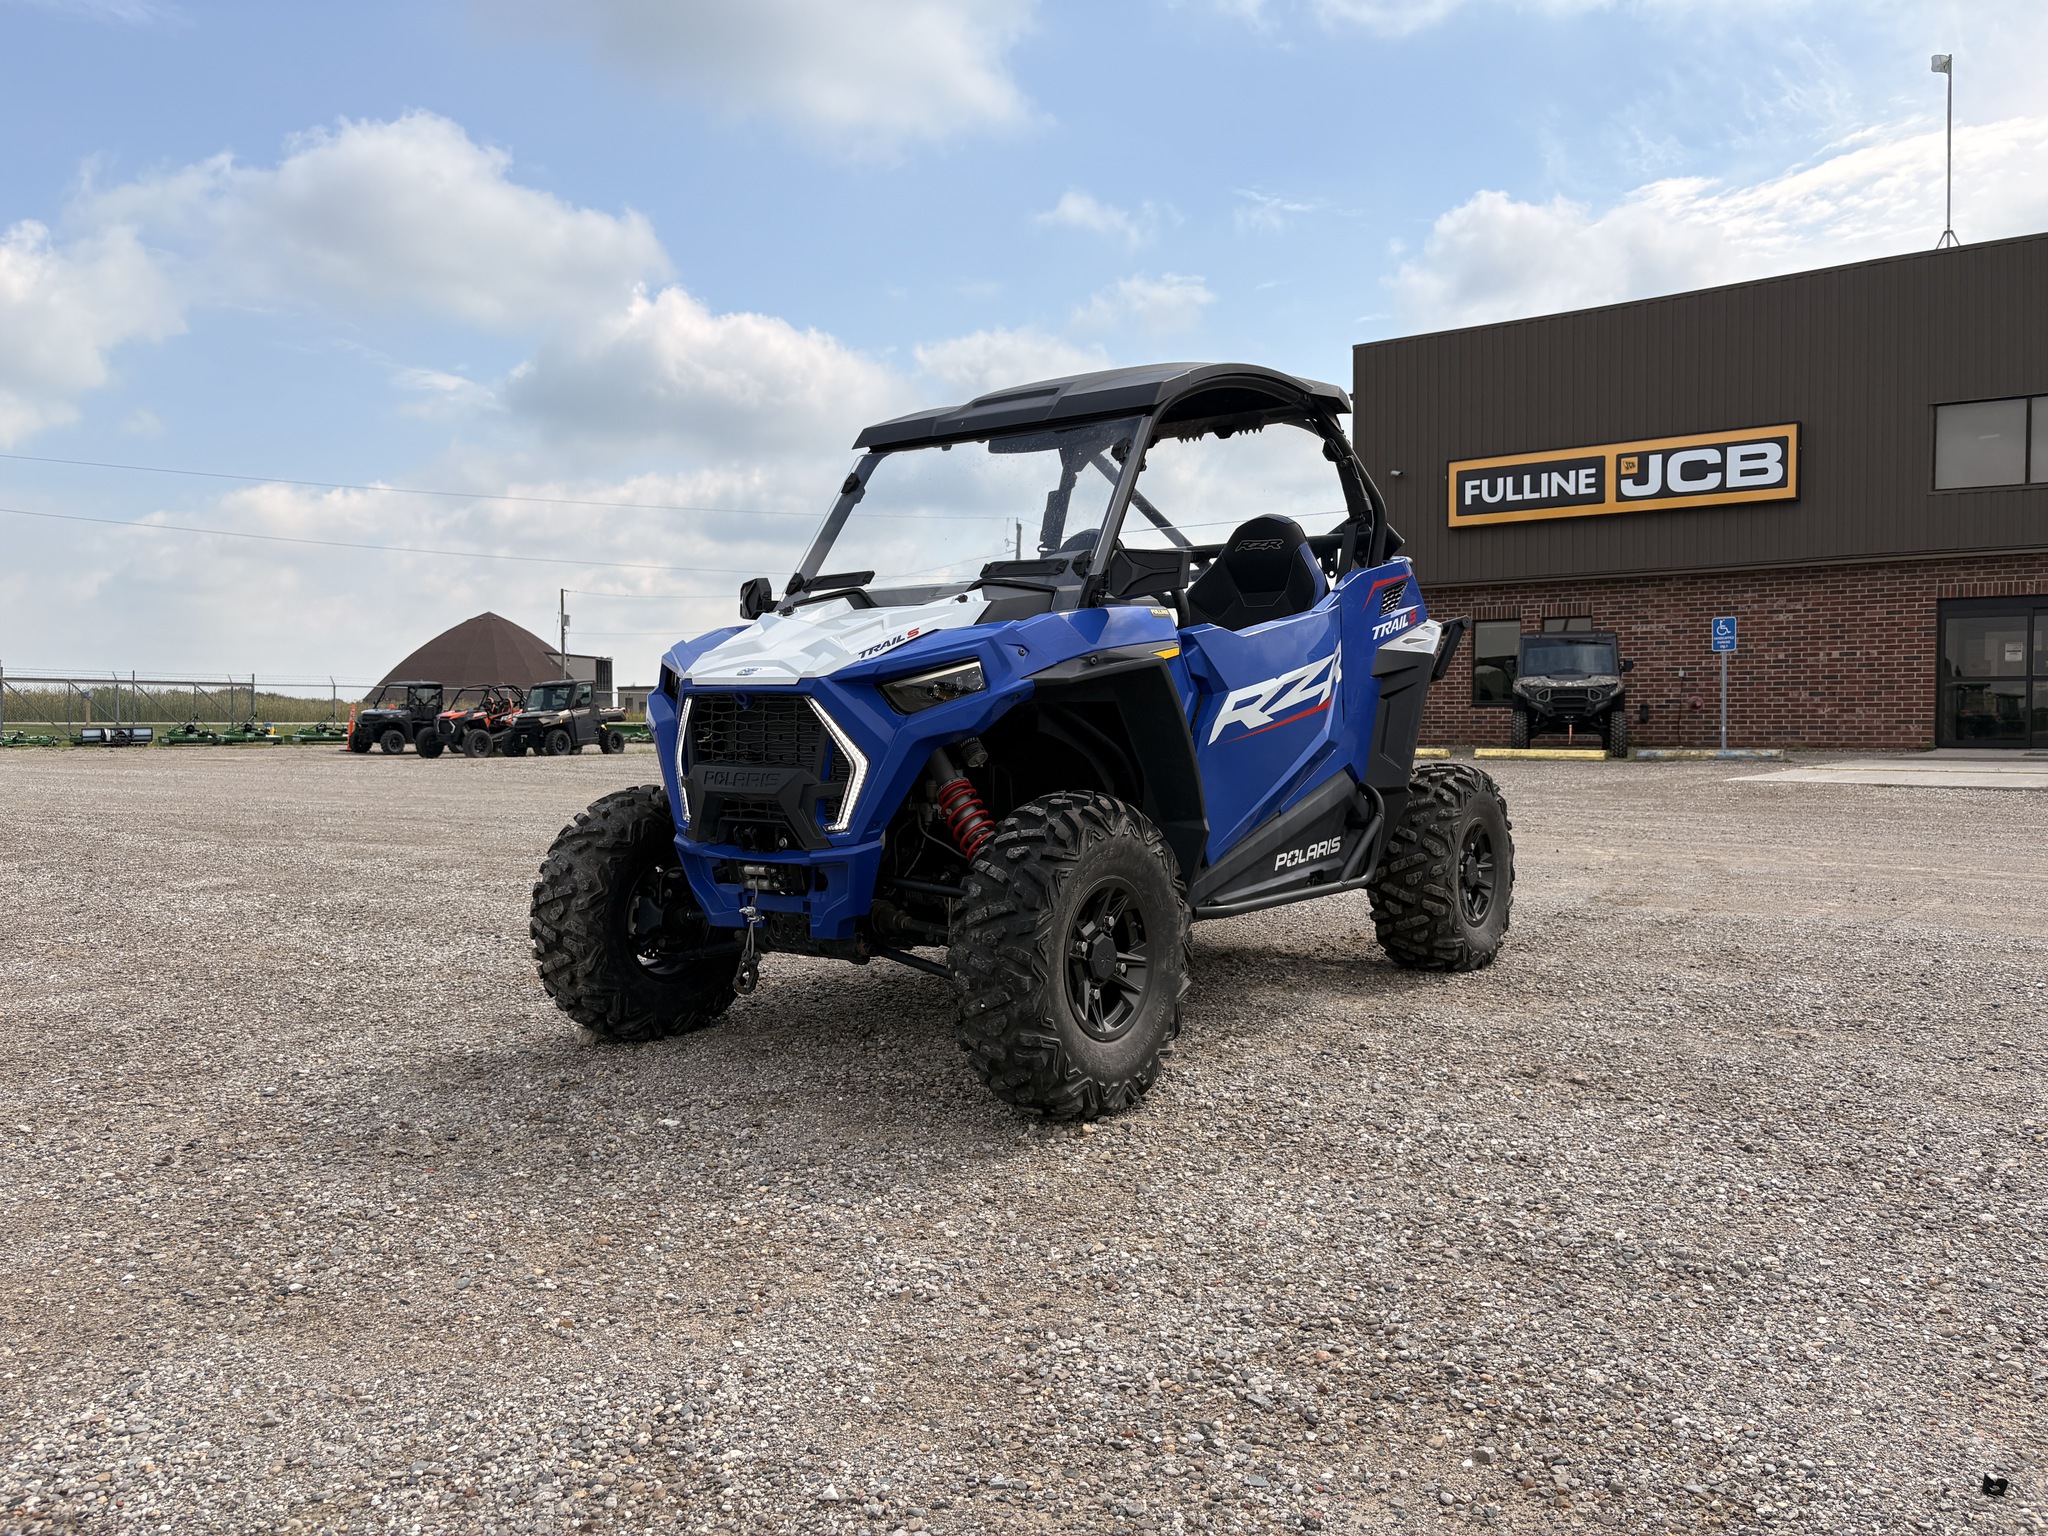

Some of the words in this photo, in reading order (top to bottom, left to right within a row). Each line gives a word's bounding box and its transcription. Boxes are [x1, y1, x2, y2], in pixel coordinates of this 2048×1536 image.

[1620, 442, 1784, 497] JCB
[1464, 468, 1597, 506] FULLINE
[1234, 538, 1285, 552] RZR
[1371, 614, 1409, 640] TRAIL
[1408, 608, 1418, 626] S
[858, 634, 905, 659] TRAIL
[906, 627, 920, 639] S
[1207, 640, 1342, 746] RZR
[703, 770, 781, 787] POLARIS
[1274, 835, 1341, 871] POLARIS
